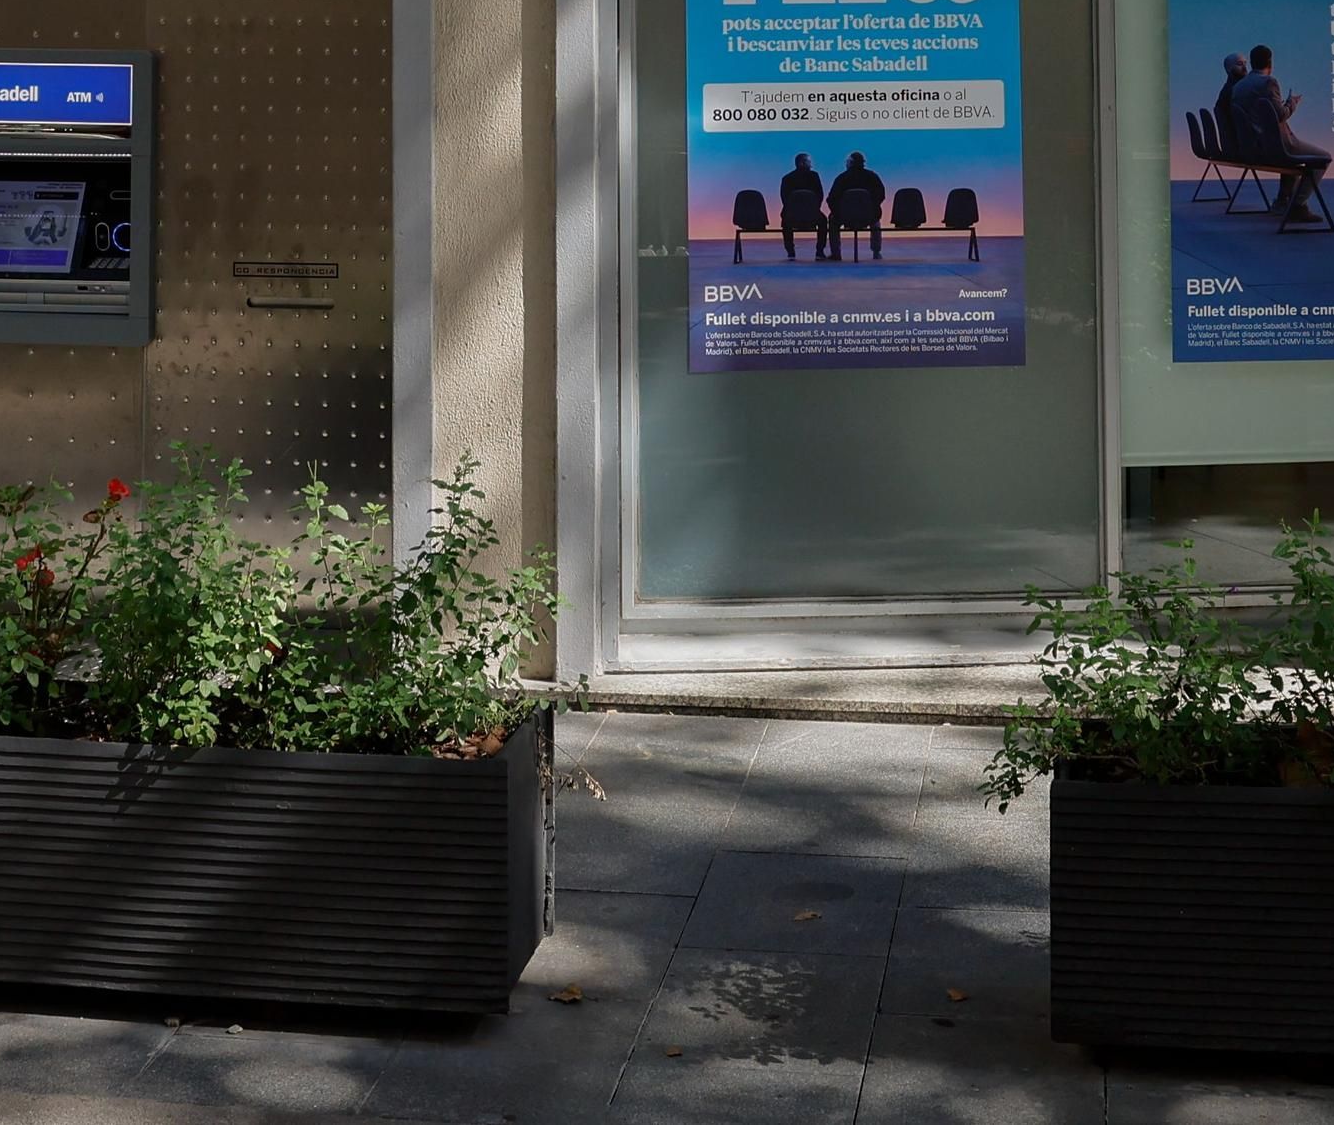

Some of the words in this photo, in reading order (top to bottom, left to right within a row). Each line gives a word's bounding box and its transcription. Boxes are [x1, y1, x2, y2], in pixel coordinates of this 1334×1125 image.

[722, 17, 760, 34] pots
[764, 16, 840, 34] acceptar
[909, 13, 929, 28] de
[934, 13, 982, 28] BBVA
[728, 36, 733, 51] i
[737, 35, 833, 51] bescanviar
[837, 35, 860, 50] les
[864, 37, 908, 50] teves
[912, 34, 978, 49] accions
[779, 57, 800, 72] de
[804, 57, 848, 72] Banc
[852, 55, 927, 71] Sabadell
[67, 92, 91, 102] ATM
[808, 93, 824, 101] en
[829, 90, 886, 104] aquesta
[891, 89, 939, 100] oficina
[944, 92, 951, 100] o
[955, 89, 965, 99] al
[713, 109, 742, 120] 800
[747, 108, 776, 120] 080
[817, 107, 856, 122] Siguis
[861, 110, 868, 118] o
[873, 110, 889, 118] no
[893, 107, 928, 118] client
[933, 107, 948, 118] de
[954, 106, 994, 117] BBVA.
[704, 283, 762, 302] BBVA
[958, 288, 1007, 297] Avancem?
[1187, 276, 1243, 294] BBVA
[705, 312, 746, 325] Fullet
[750, 311, 825, 326] disponible
[830, 314, 838, 322] a
[843, 313, 900, 322] cnmv.es
[905, 310, 908, 321] i
[913, 312, 921, 321] a
[926, 308, 994, 321] bbva.com
[1188, 305, 1224, 317] Fullet
[1228, 304, 1296, 318] disponible
[1301, 307, 1308, 315] a
